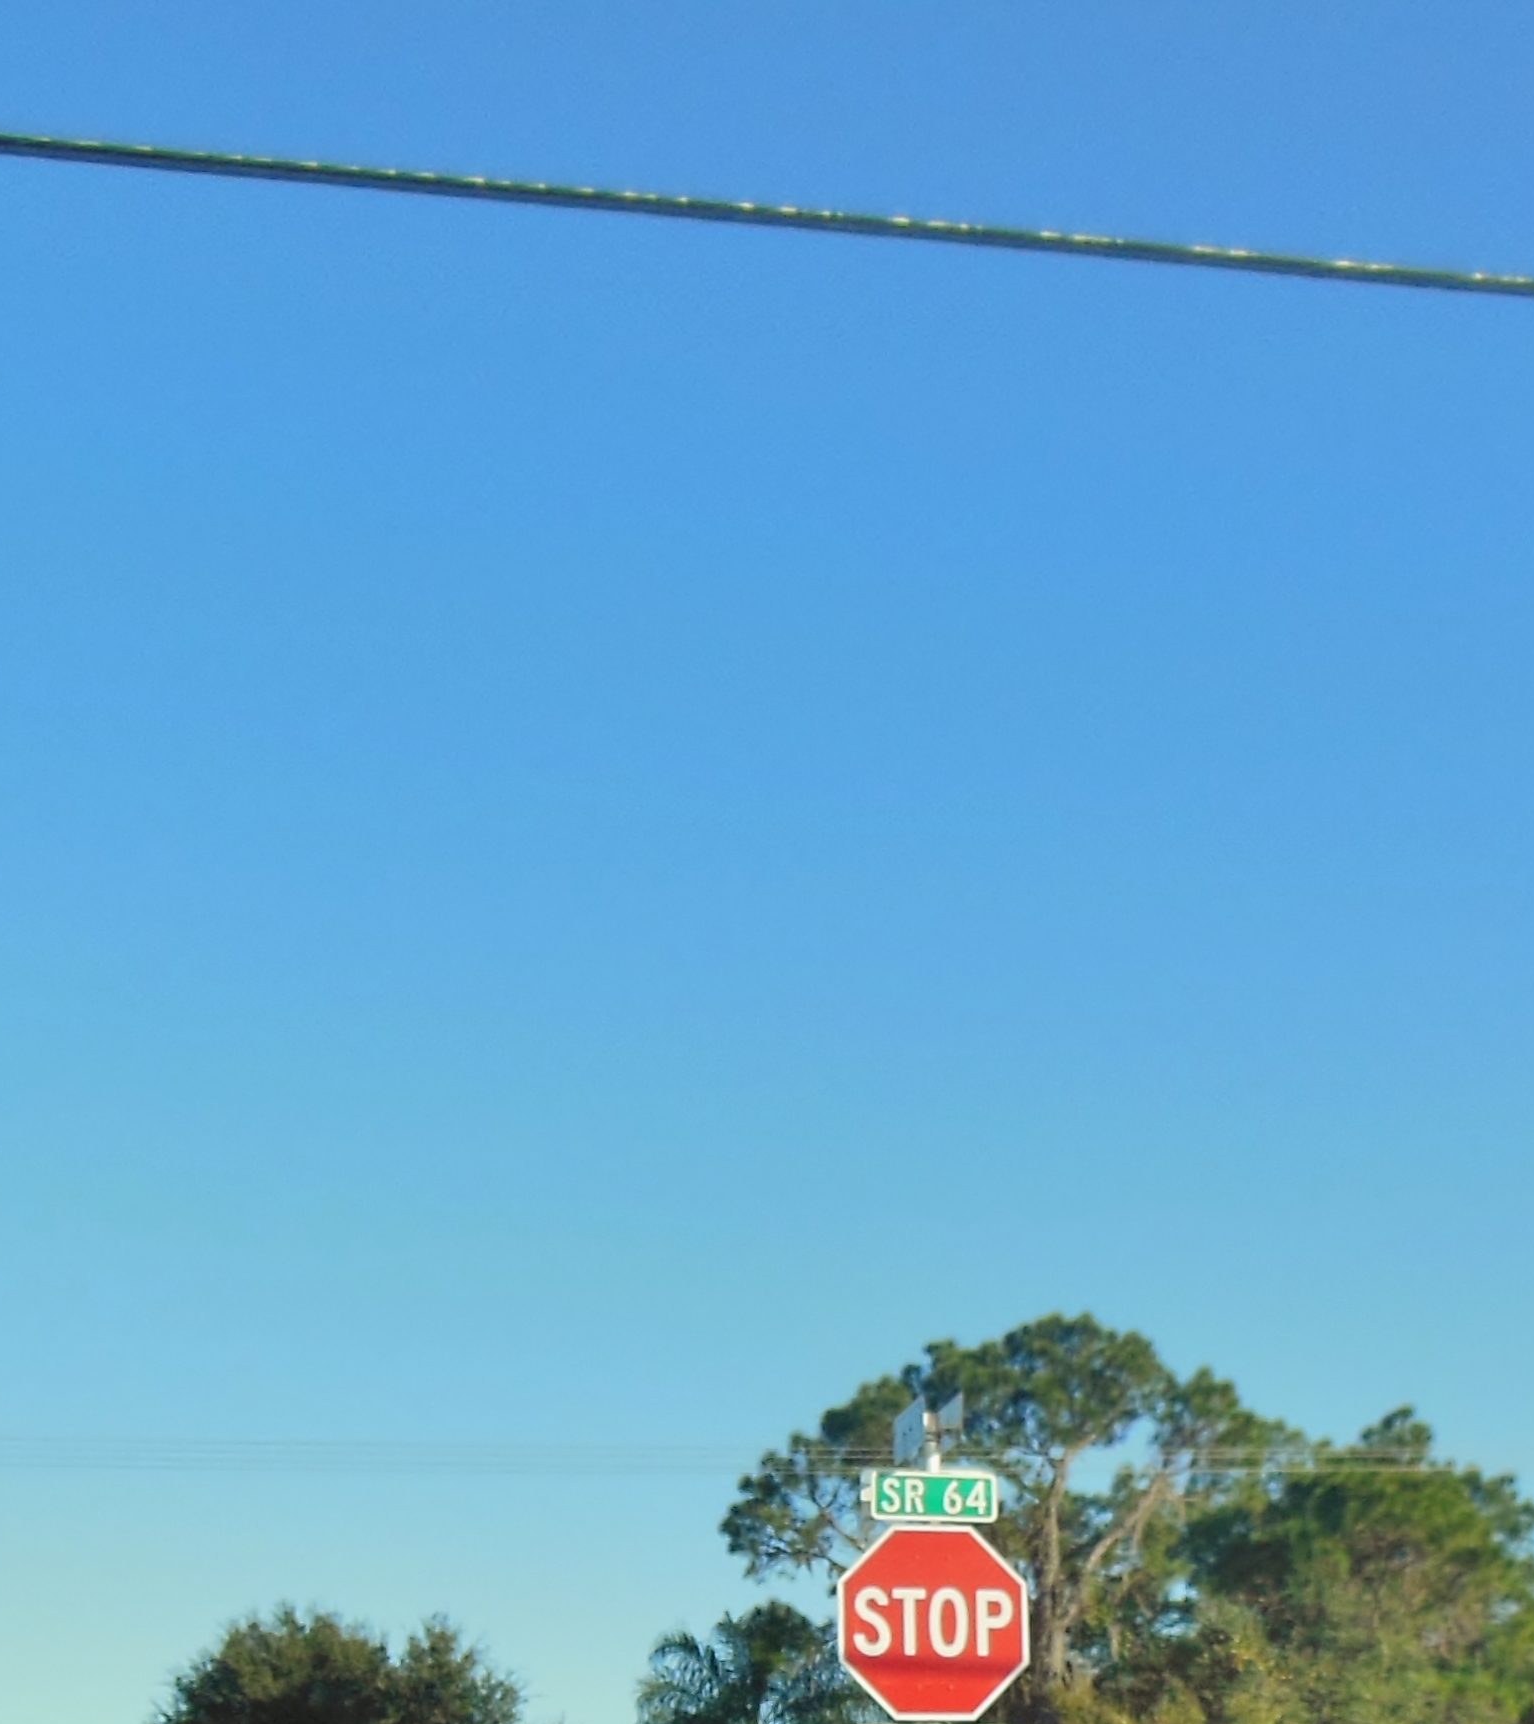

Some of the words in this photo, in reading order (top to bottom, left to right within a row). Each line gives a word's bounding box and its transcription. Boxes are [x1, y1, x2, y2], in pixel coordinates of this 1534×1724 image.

[881, 1477, 925, 1513] SR
[942, 1479, 988, 1516] 64
[853, 1586, 1014, 1658] STOP
